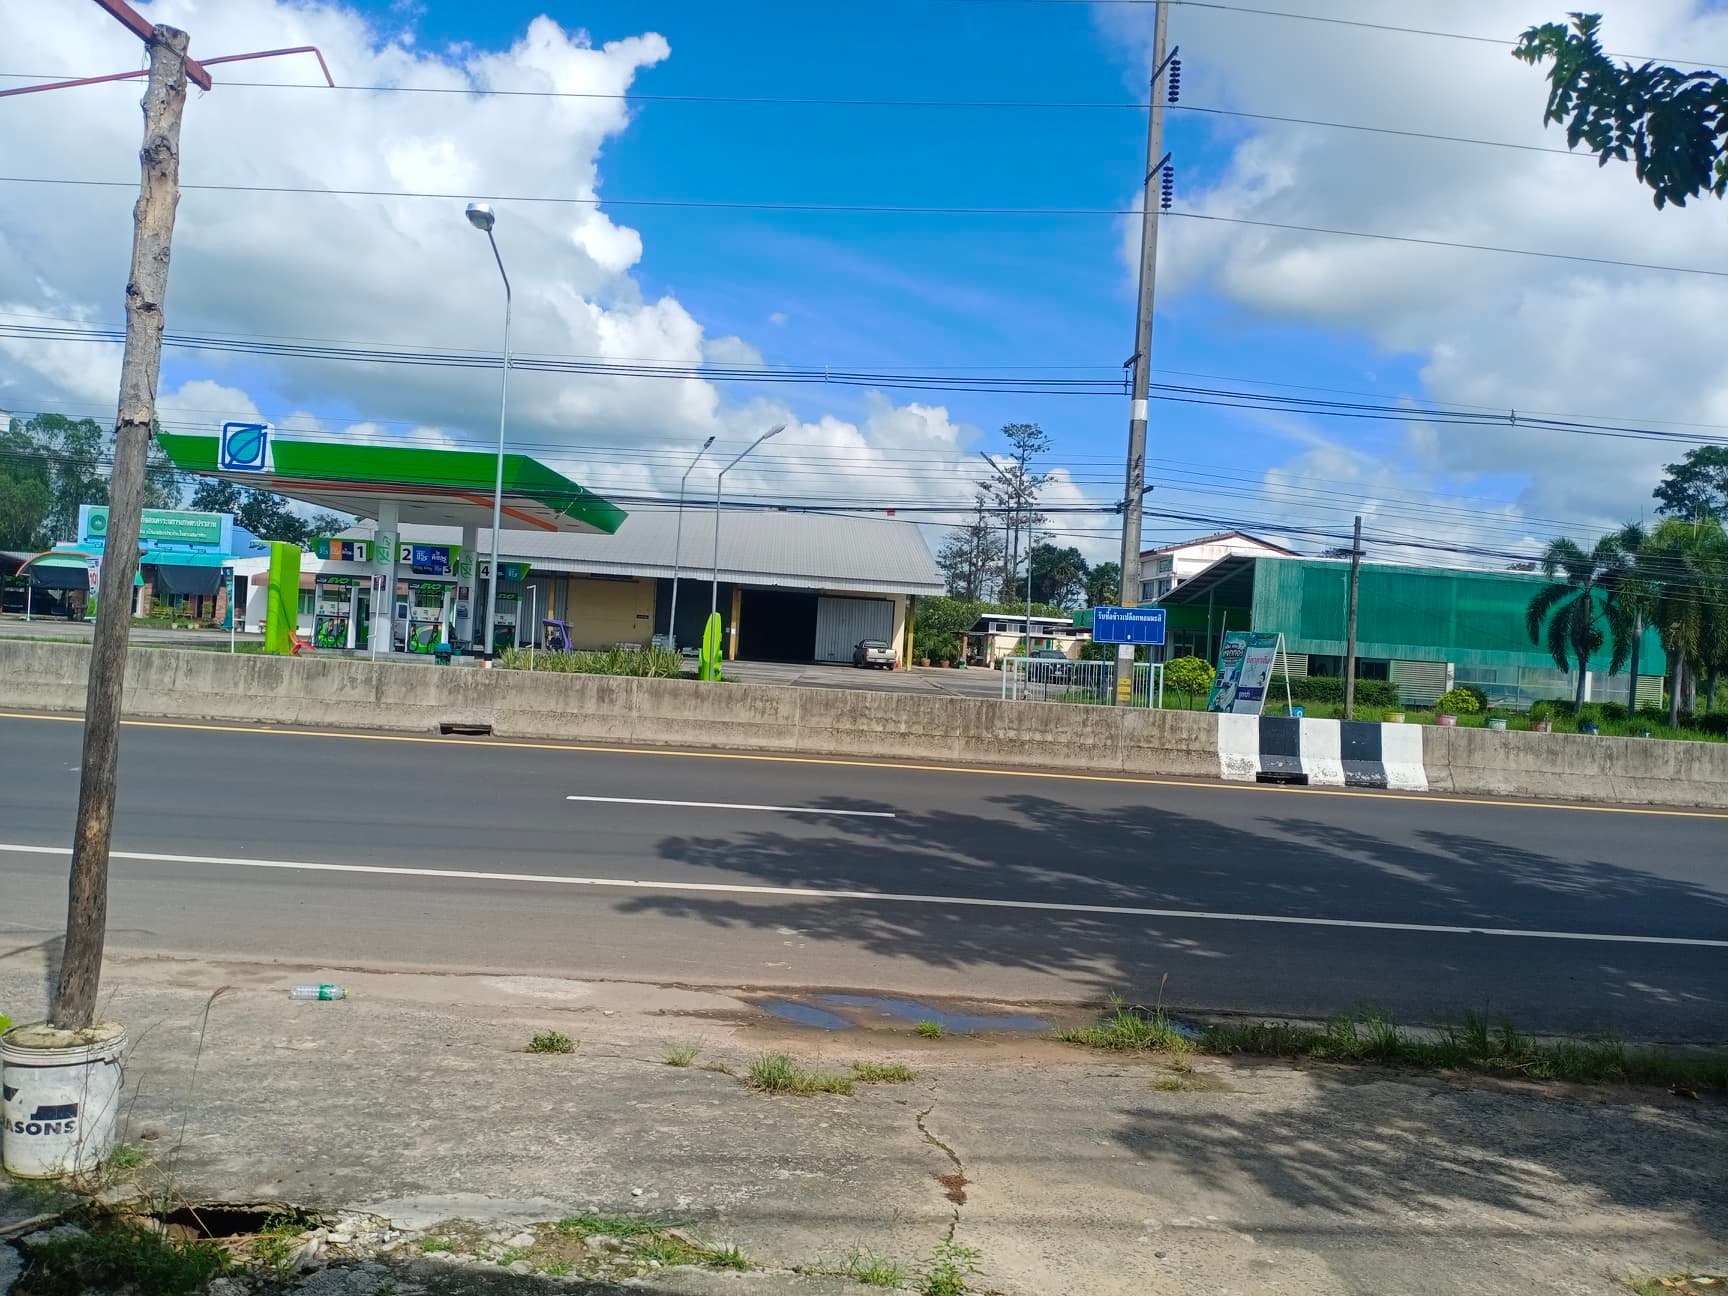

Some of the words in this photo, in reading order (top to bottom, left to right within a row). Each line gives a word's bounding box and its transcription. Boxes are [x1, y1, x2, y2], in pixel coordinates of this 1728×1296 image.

[357, 546, 365, 560] 1
[402, 549, 411, 561] 2
[444, 566, 452, 574] 3
[481, 566, 490, 577] 4
